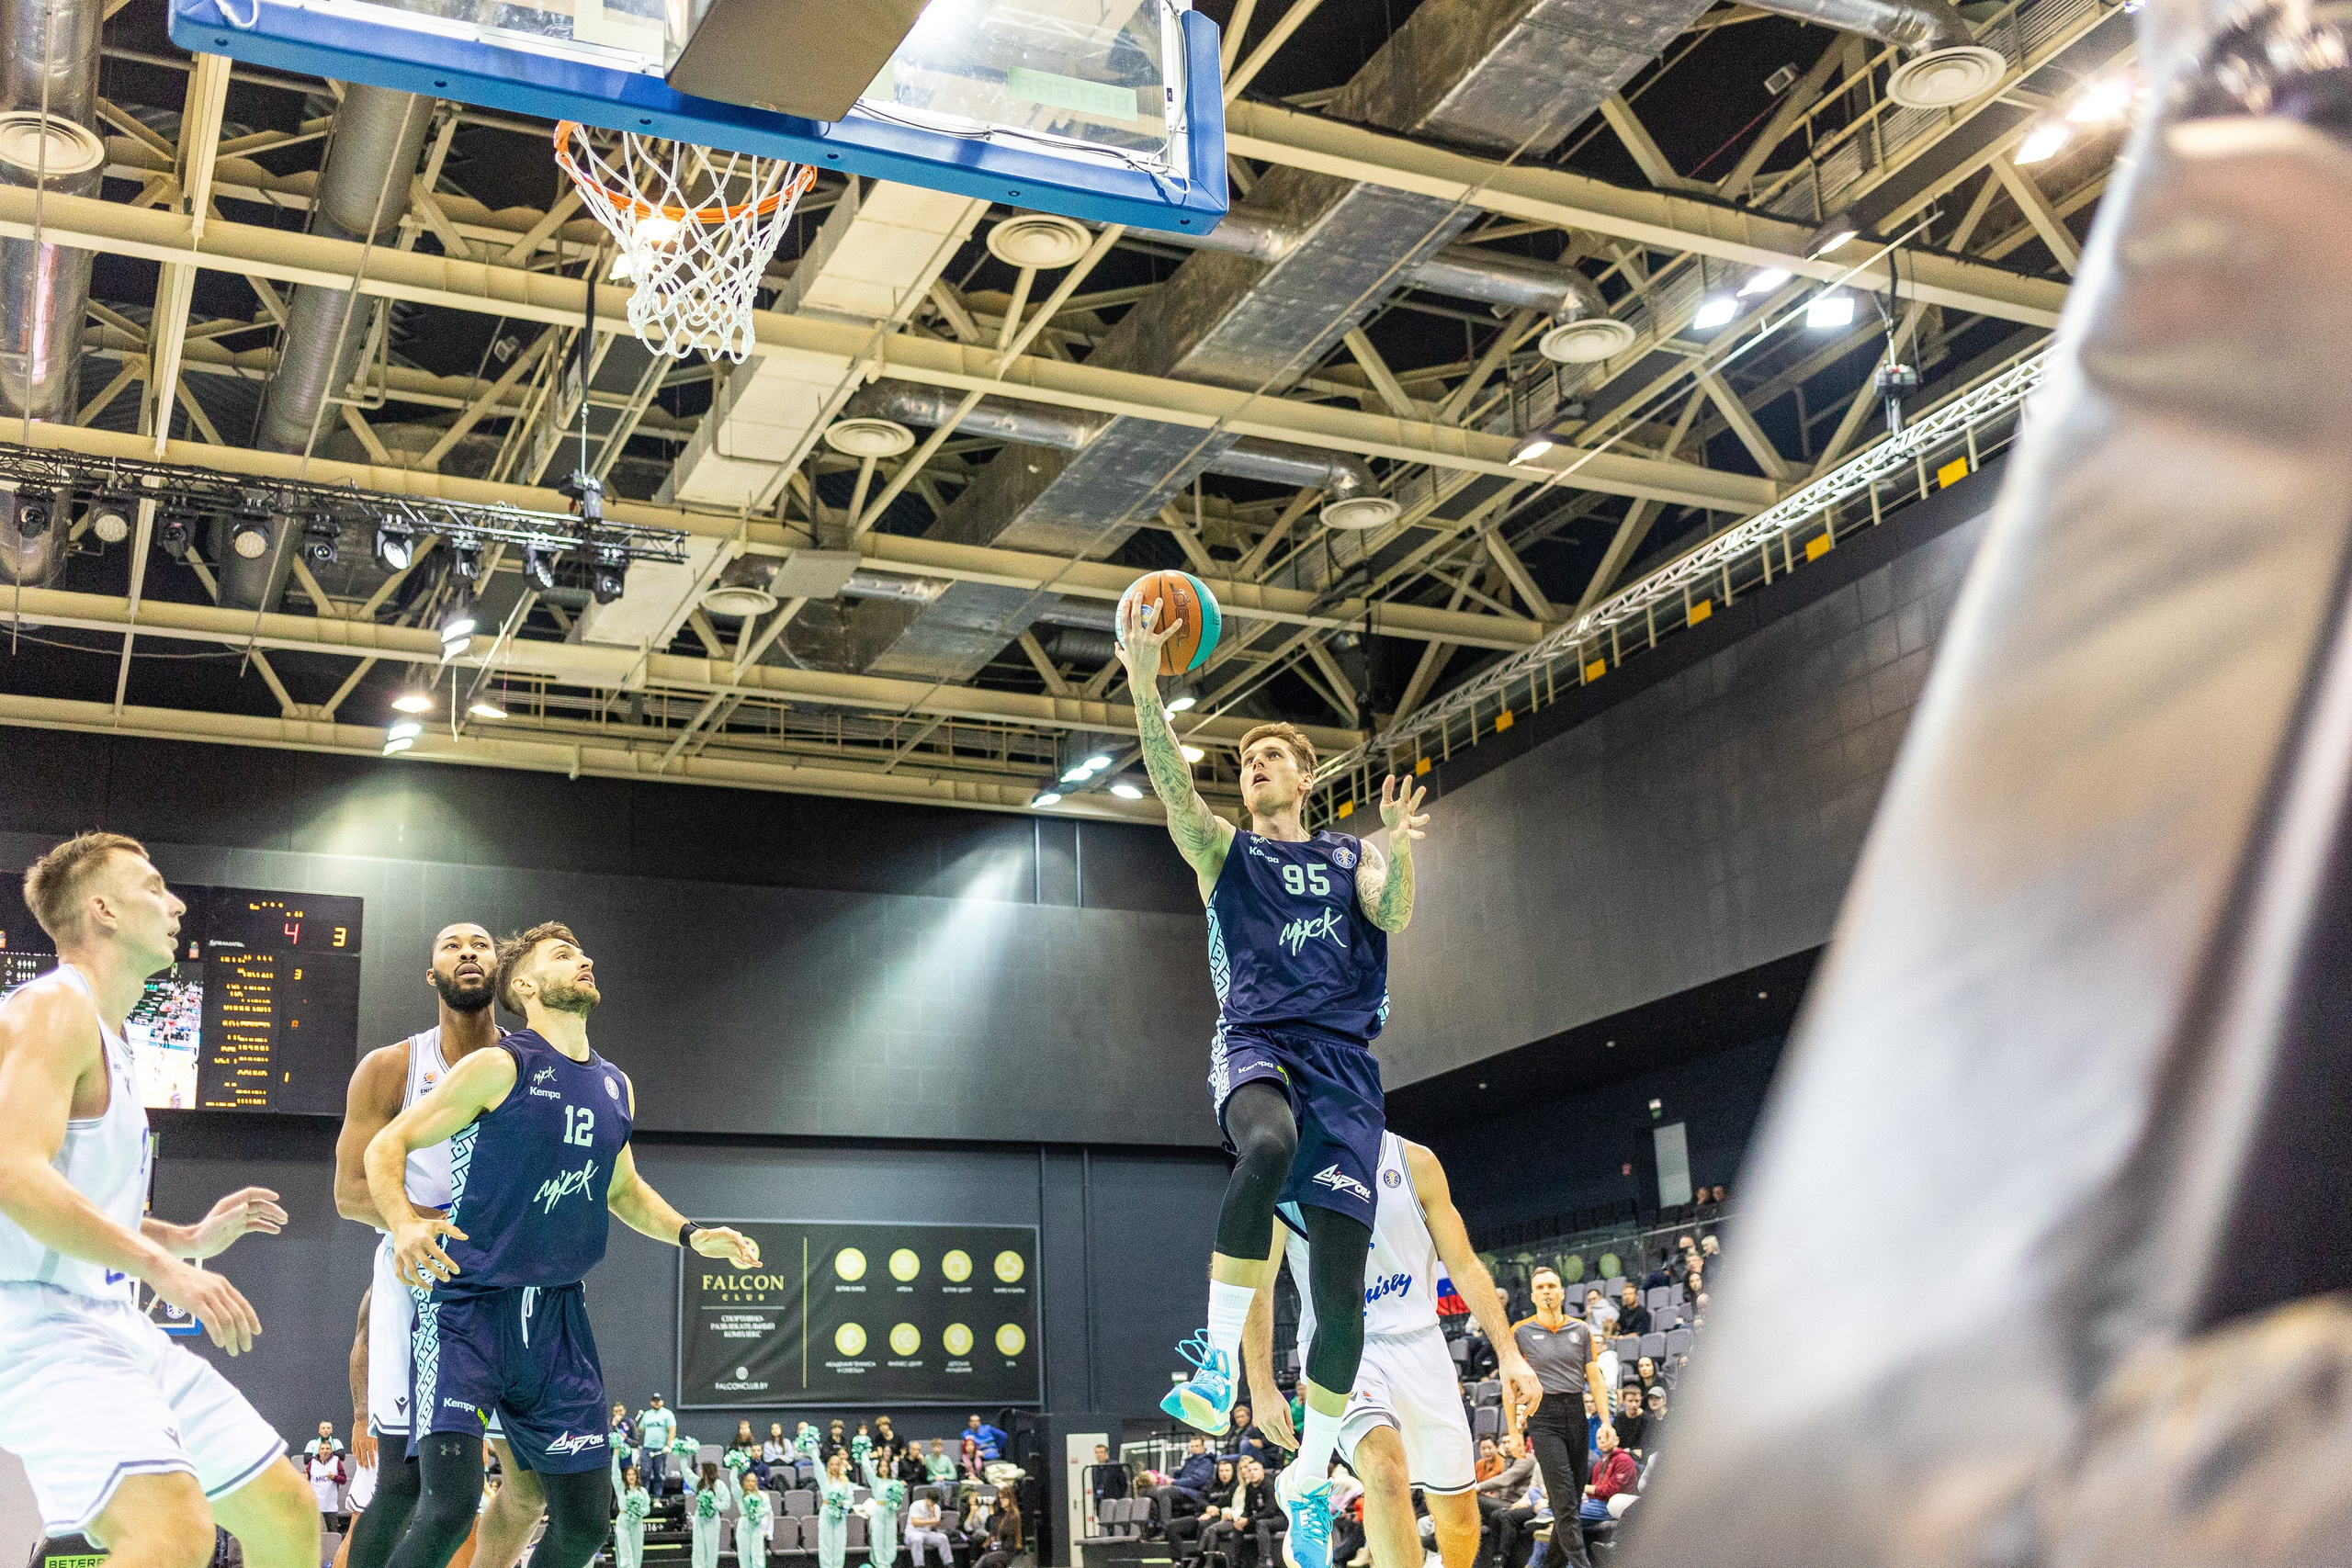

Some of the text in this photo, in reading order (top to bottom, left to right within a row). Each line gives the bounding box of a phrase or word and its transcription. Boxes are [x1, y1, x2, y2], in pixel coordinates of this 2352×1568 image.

[1250, 846, 1279, 863] Kepa
[1282, 863, 1330, 897] 95
[284, 922, 300, 945] 4
[333, 927, 347, 947] 3
[1238, 1060, 1273, 1074] Kempa
[529, 1086, 561, 1100] Kempa
[563, 1104, 595, 1147] 12
[702, 1274, 785, 1291] FALCON
[1364, 1273, 1412, 1308] nisey
[721, 1293, 764, 1302] CLUB
[444, 1397, 475, 1413] Kempa
